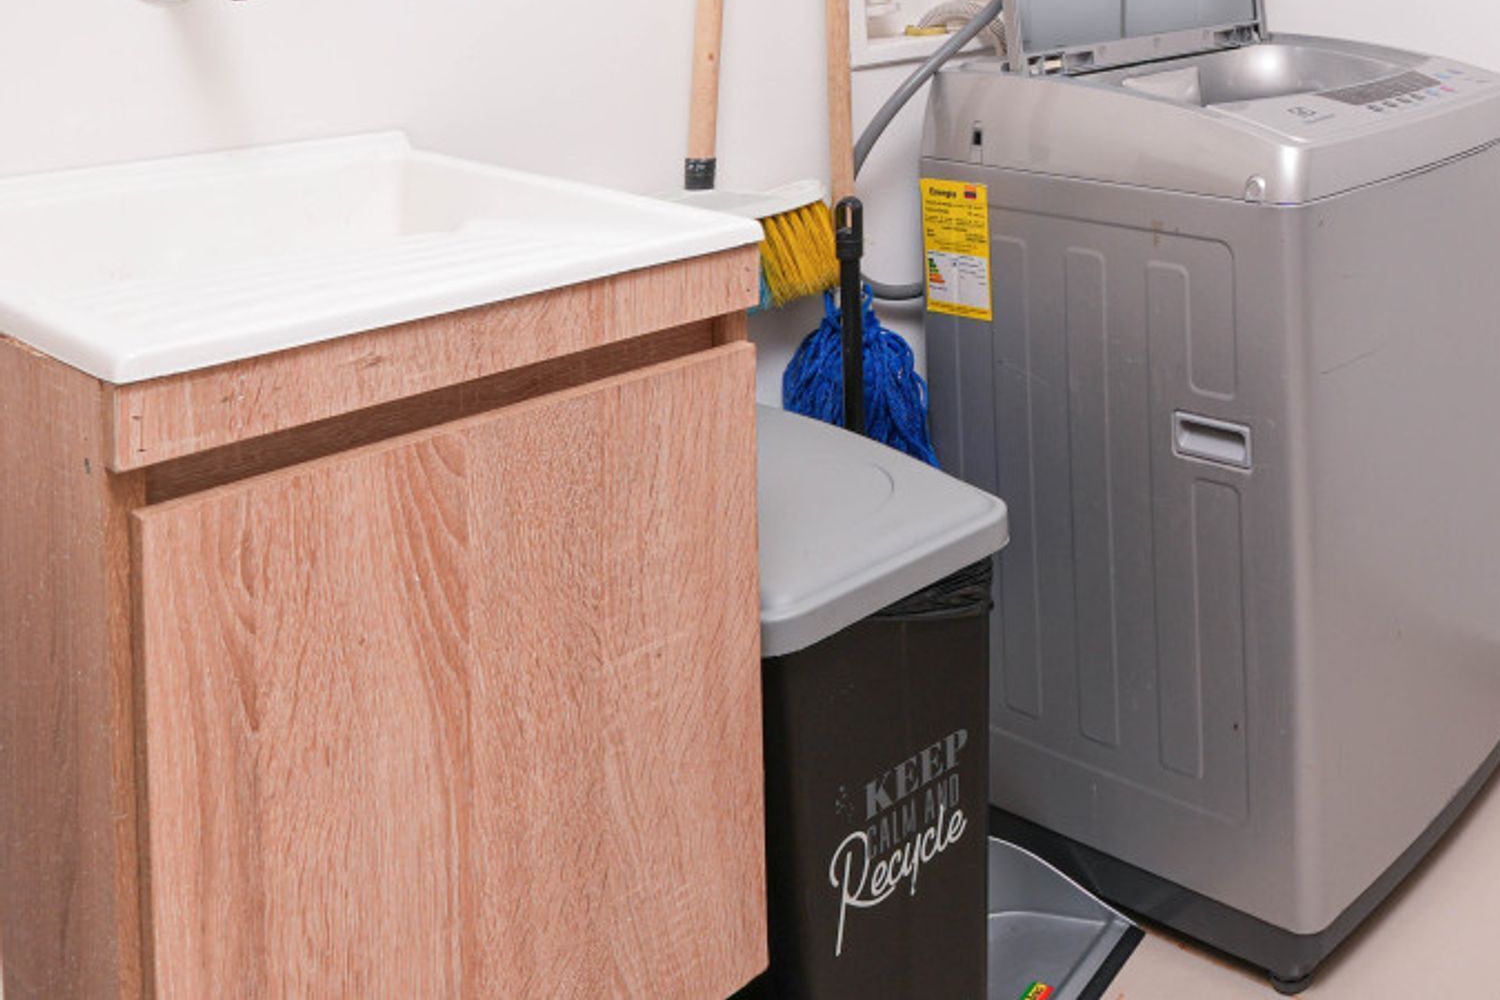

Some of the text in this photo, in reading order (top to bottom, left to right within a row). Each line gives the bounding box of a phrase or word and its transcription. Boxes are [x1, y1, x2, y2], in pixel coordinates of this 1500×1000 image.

[865, 728, 969, 819] KEEP
[866, 773, 961, 859] CALM AND
[829, 804, 968, 957] Recycle
